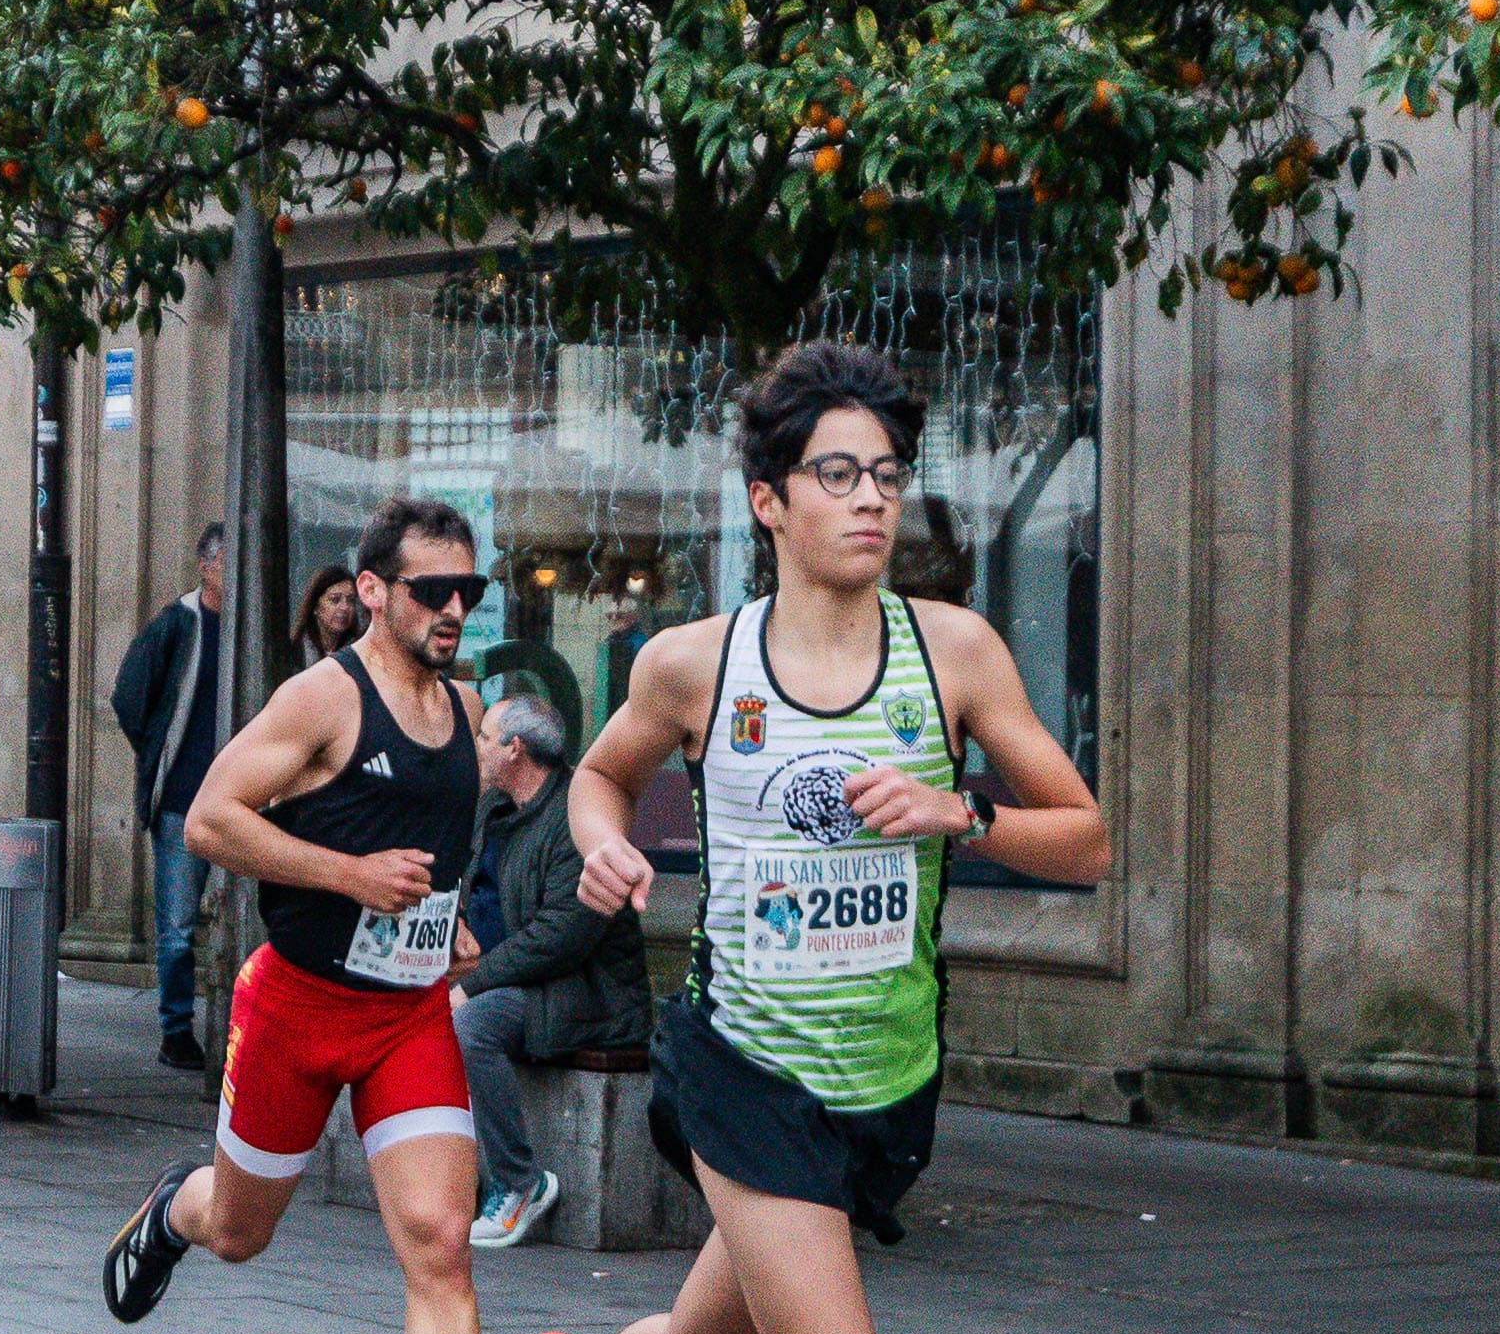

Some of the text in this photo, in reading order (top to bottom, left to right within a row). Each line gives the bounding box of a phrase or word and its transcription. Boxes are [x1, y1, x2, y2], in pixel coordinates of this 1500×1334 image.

[789, 857, 824, 885] SAN
[829, 849, 908, 884] SILVESTRE
[807, 880, 909, 930] 2688
[807, 926, 906, 953] PONTEVEDRA 2025
